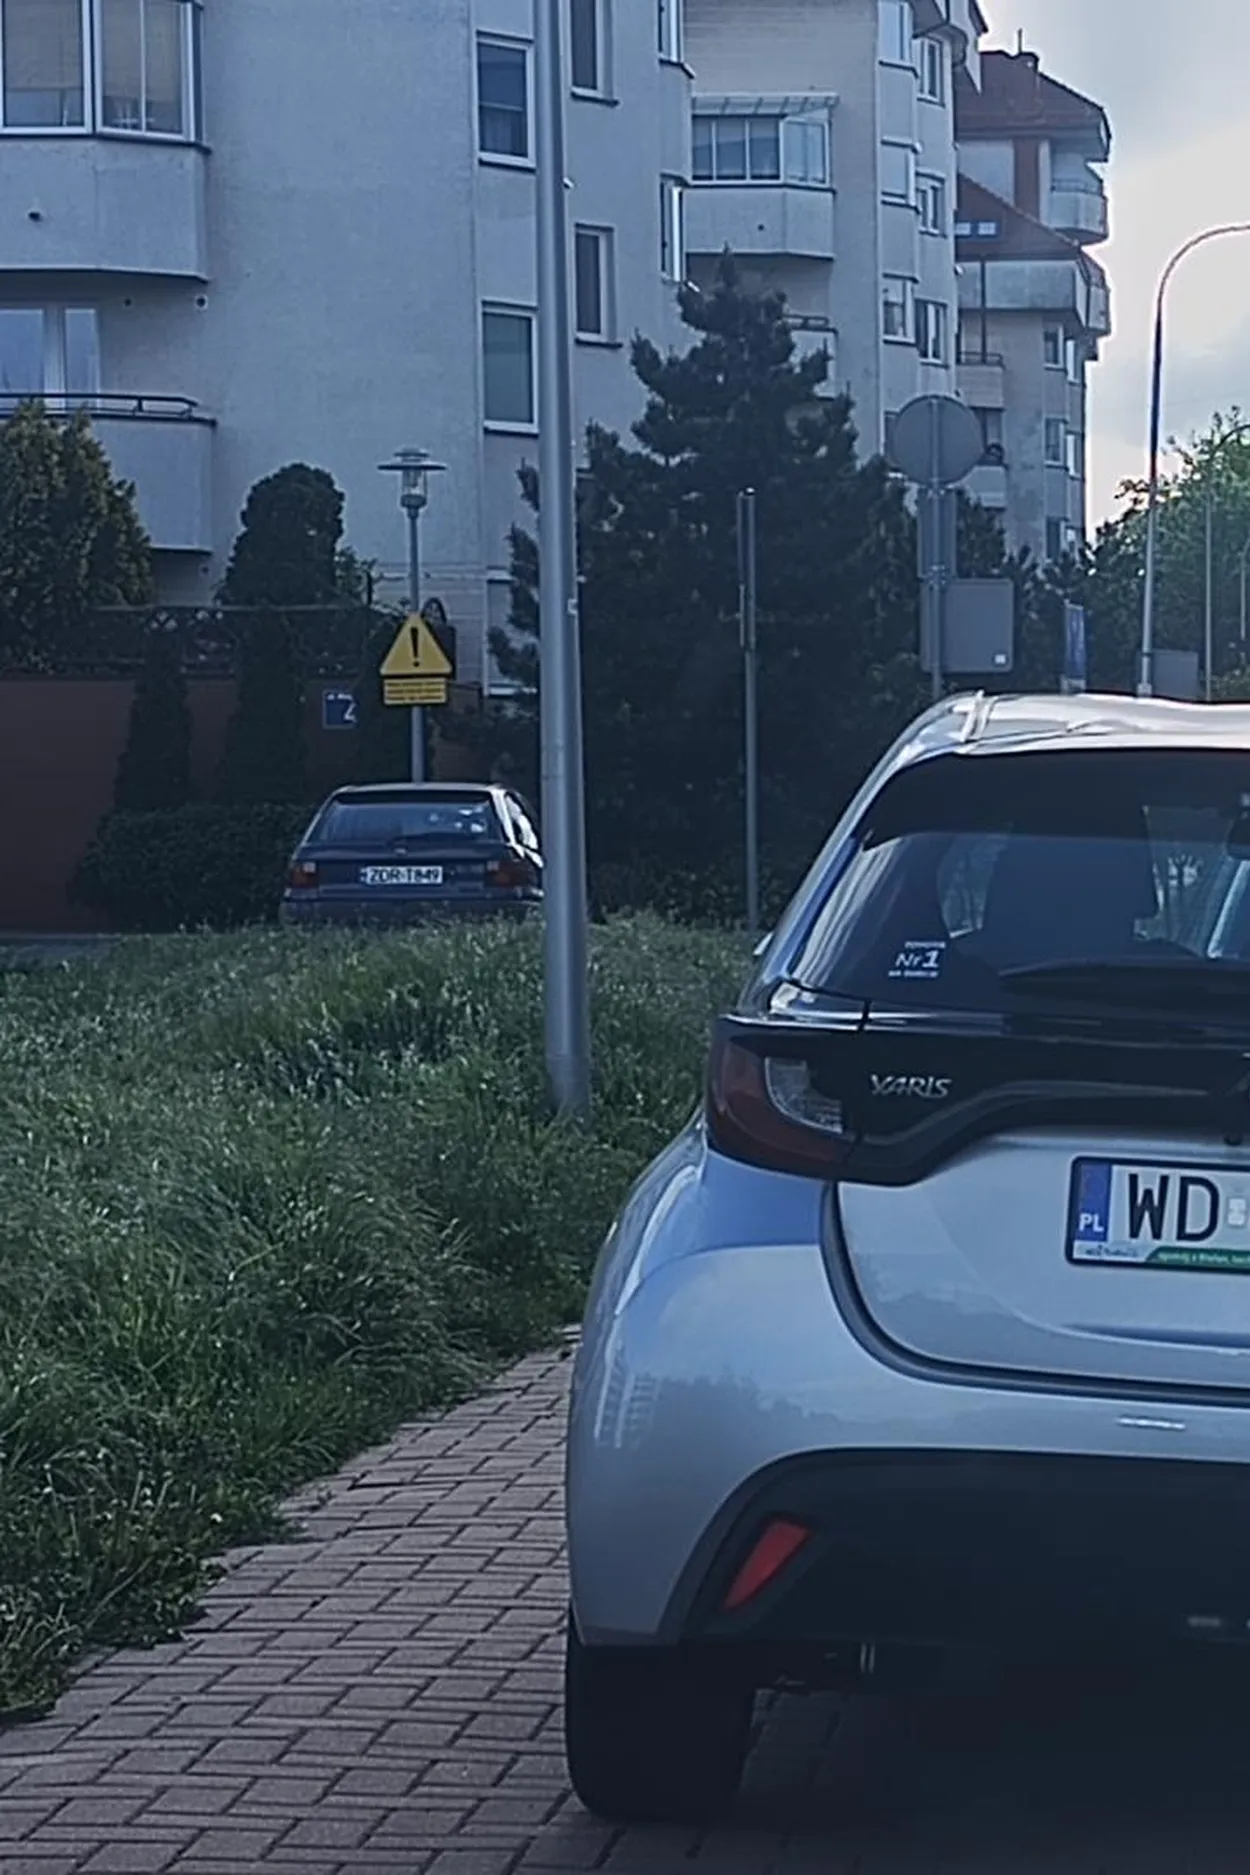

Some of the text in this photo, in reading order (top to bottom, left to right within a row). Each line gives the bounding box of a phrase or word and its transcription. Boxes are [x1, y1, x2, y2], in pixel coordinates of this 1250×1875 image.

[871, 1074, 952, 1098] YARIS
[1128, 1172, 1220, 1243] WD
[1079, 1213, 1105, 1232] PL
